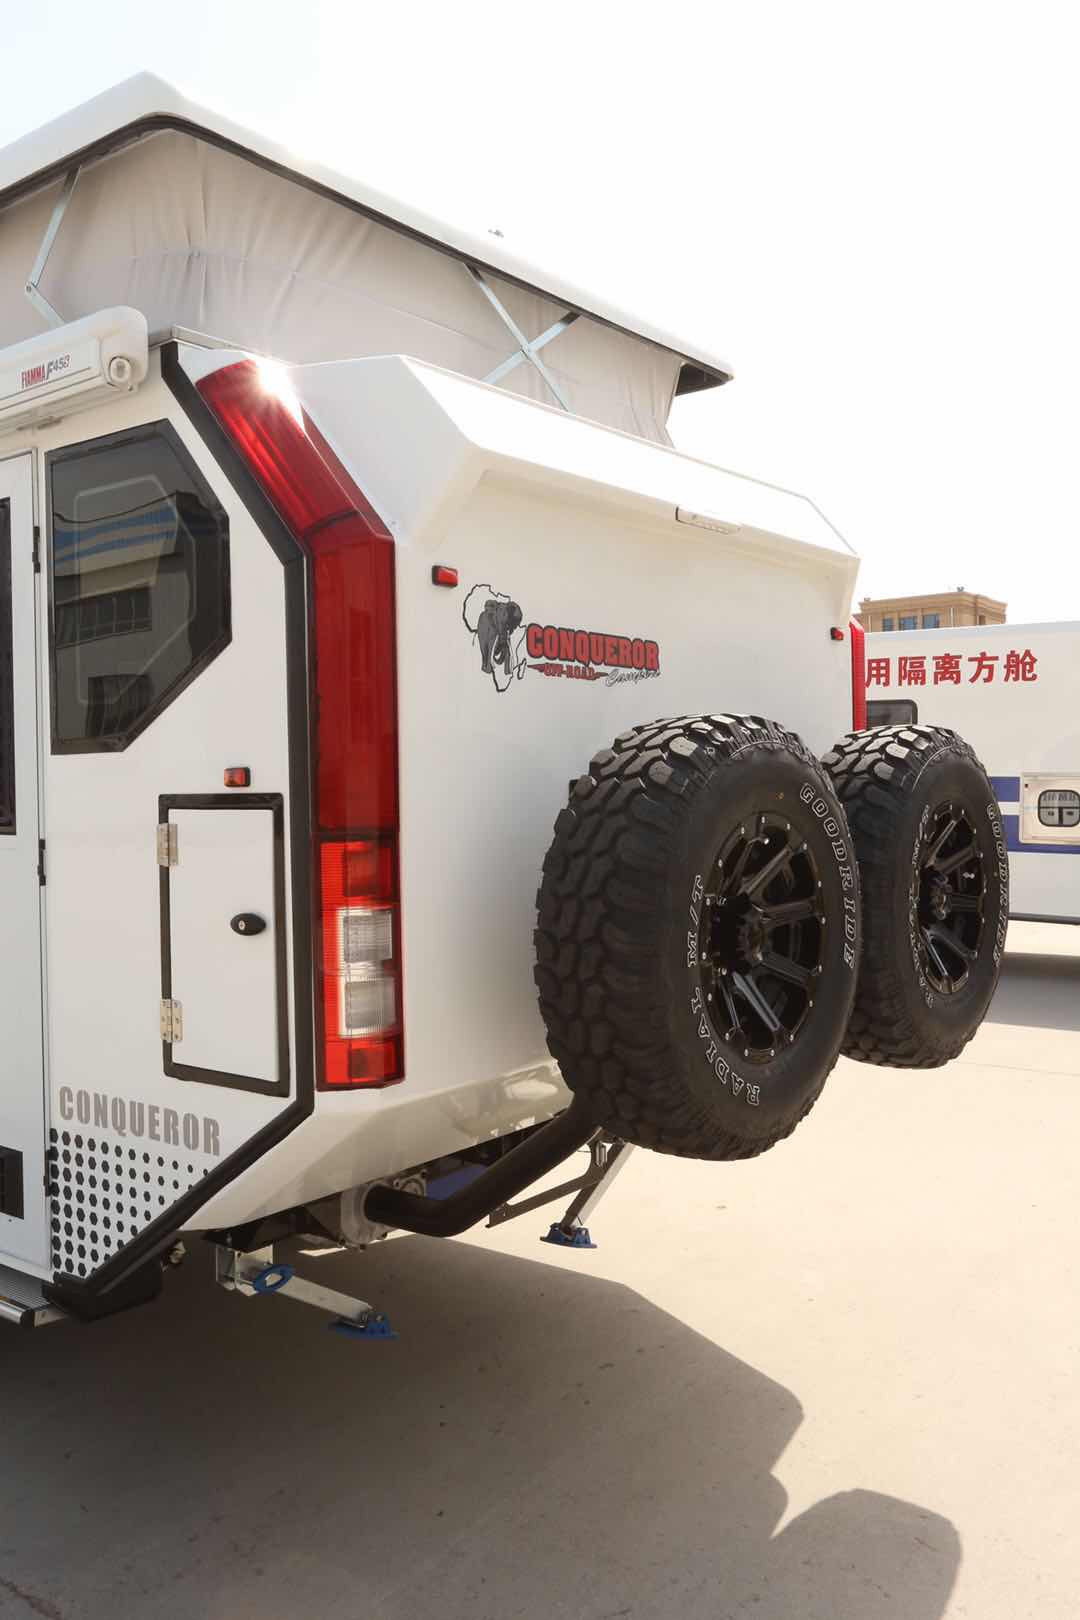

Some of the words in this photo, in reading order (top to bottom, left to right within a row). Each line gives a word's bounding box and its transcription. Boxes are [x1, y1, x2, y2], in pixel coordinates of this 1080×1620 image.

[21, 363, 46, 389] FIAMMA
[526, 623, 660, 672] CONQUEROR
[865, 649, 1038, 688] 用隔离方舱
[799, 783, 856, 969] GOODRIDE
[691, 987, 761, 1106] RADIAL
[59, 1086, 220, 1156] CONQUEROR
